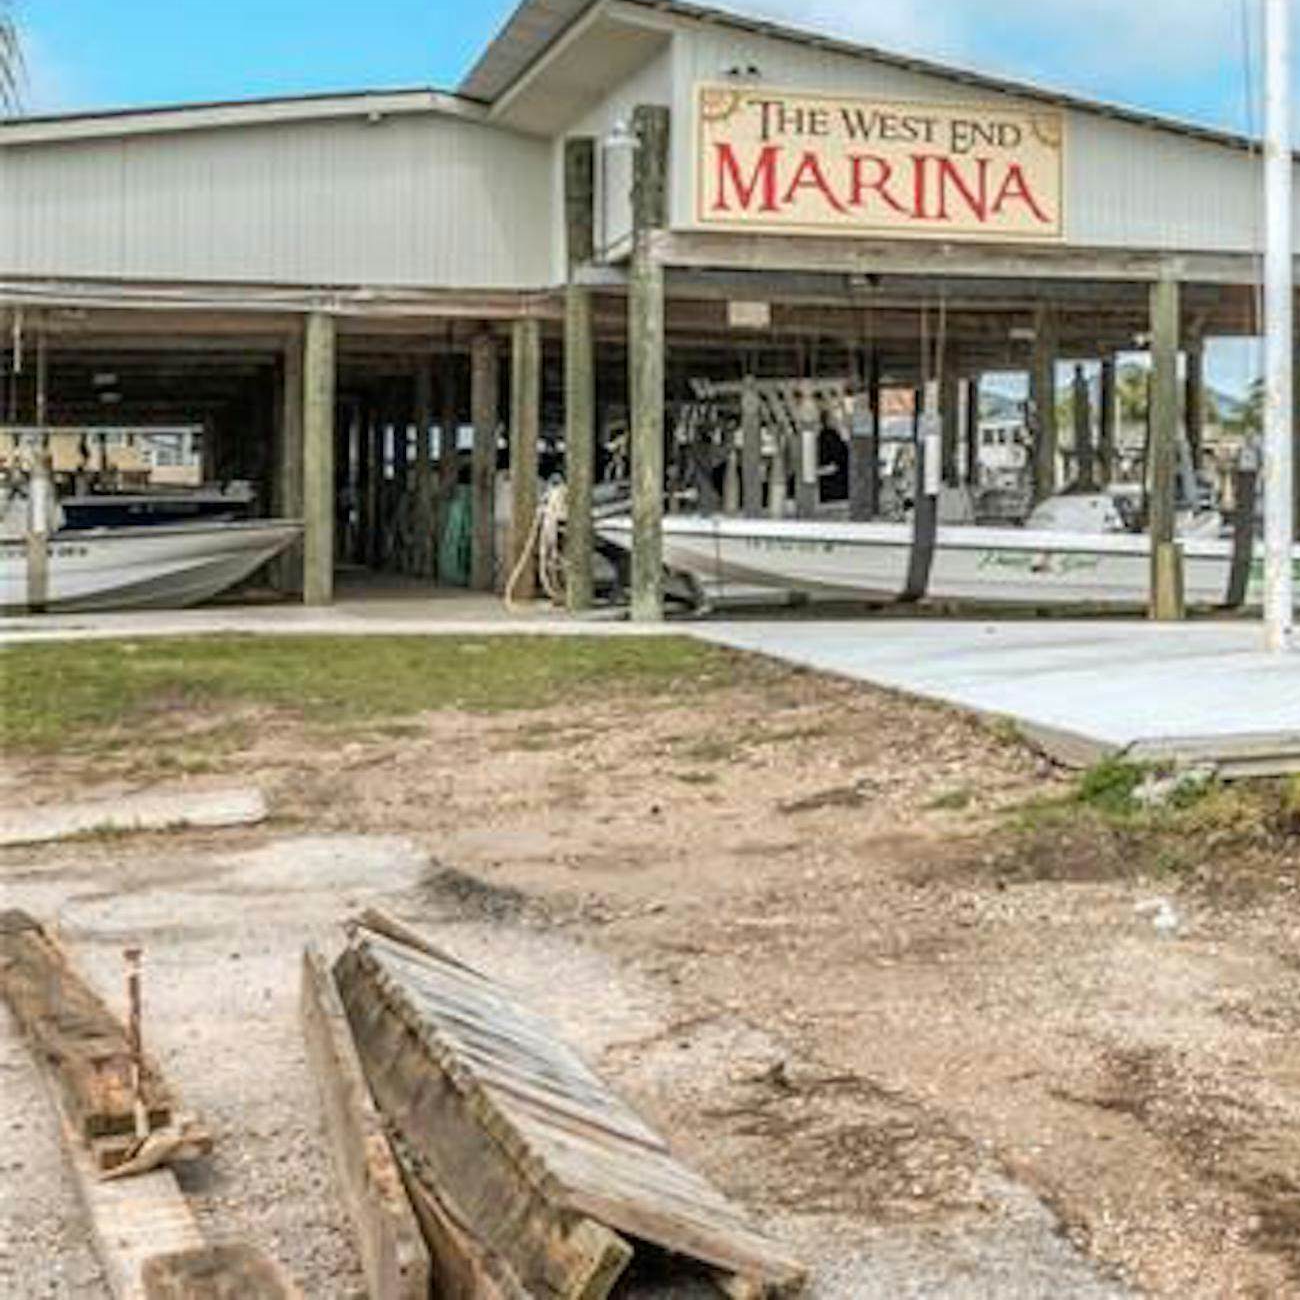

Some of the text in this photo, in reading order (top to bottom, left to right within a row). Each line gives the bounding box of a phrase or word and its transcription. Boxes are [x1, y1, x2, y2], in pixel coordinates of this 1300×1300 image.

[748, 101, 1022, 155] THE WEST END
[712, 142, 1052, 224] MARINA
